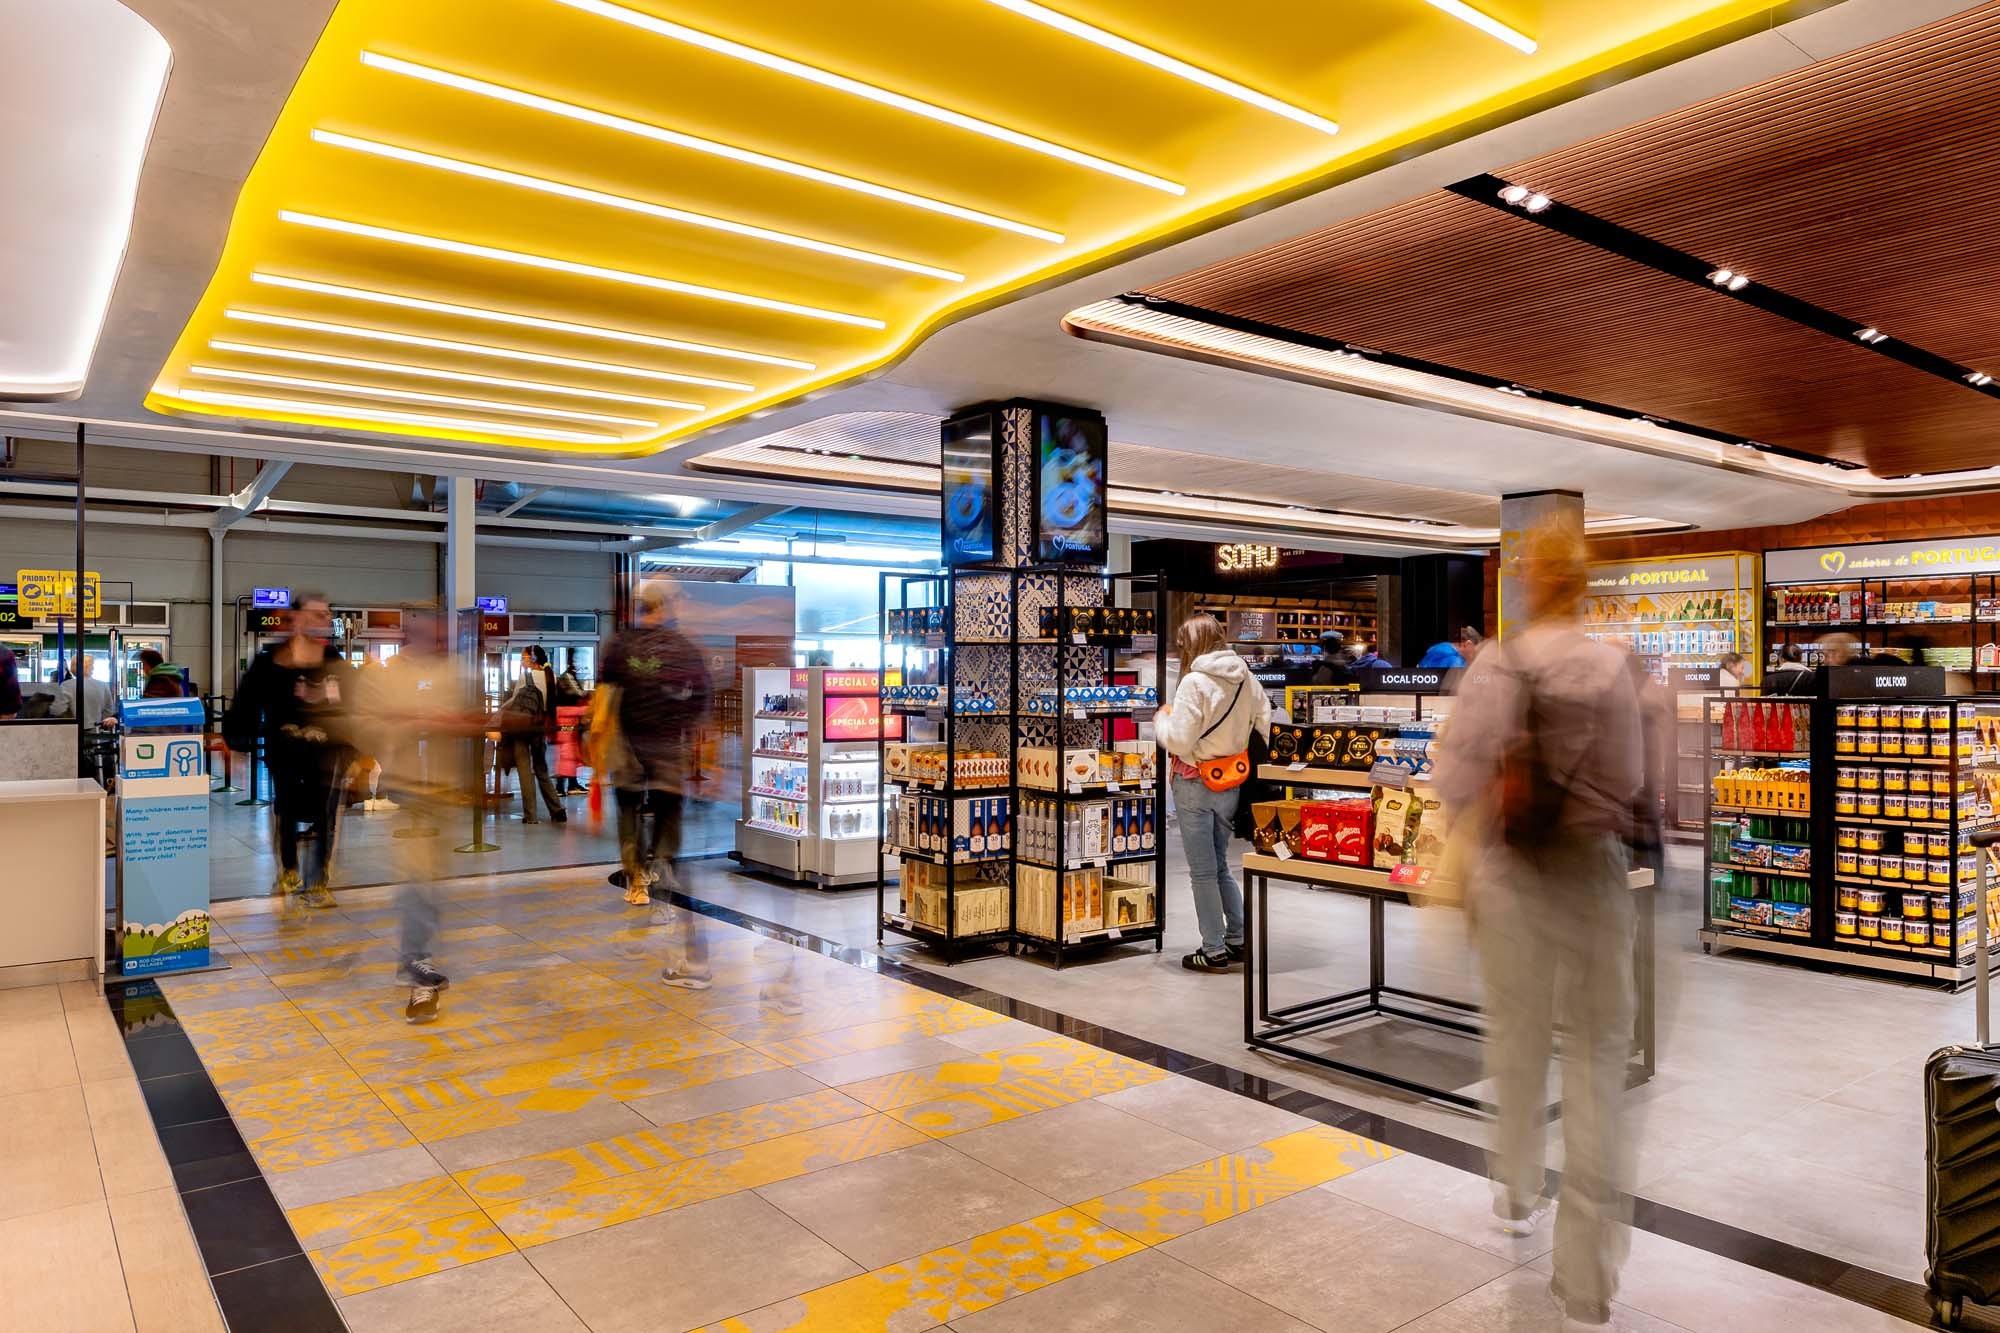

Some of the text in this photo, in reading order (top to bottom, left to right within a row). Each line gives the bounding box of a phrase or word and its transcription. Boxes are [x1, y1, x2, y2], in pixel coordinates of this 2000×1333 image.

[1065, 543, 1091, 551] PORTUGAL
[1218, 543, 1277, 570] SOHO
[1848, 546, 2000, 569] sabores de PORTUGA
[1630, 569, 1710, 586] PORTUGAL
[260, 616, 281, 626] 203
[796, 674, 808, 682] SPEC
[826, 677, 867, 686] SPECIAL
[1382, 674, 1438, 684] LOCAL FOOD
[1875, 676, 1907, 687] LOCAL FOOD
[832, 718, 866, 726] SPECIAL
